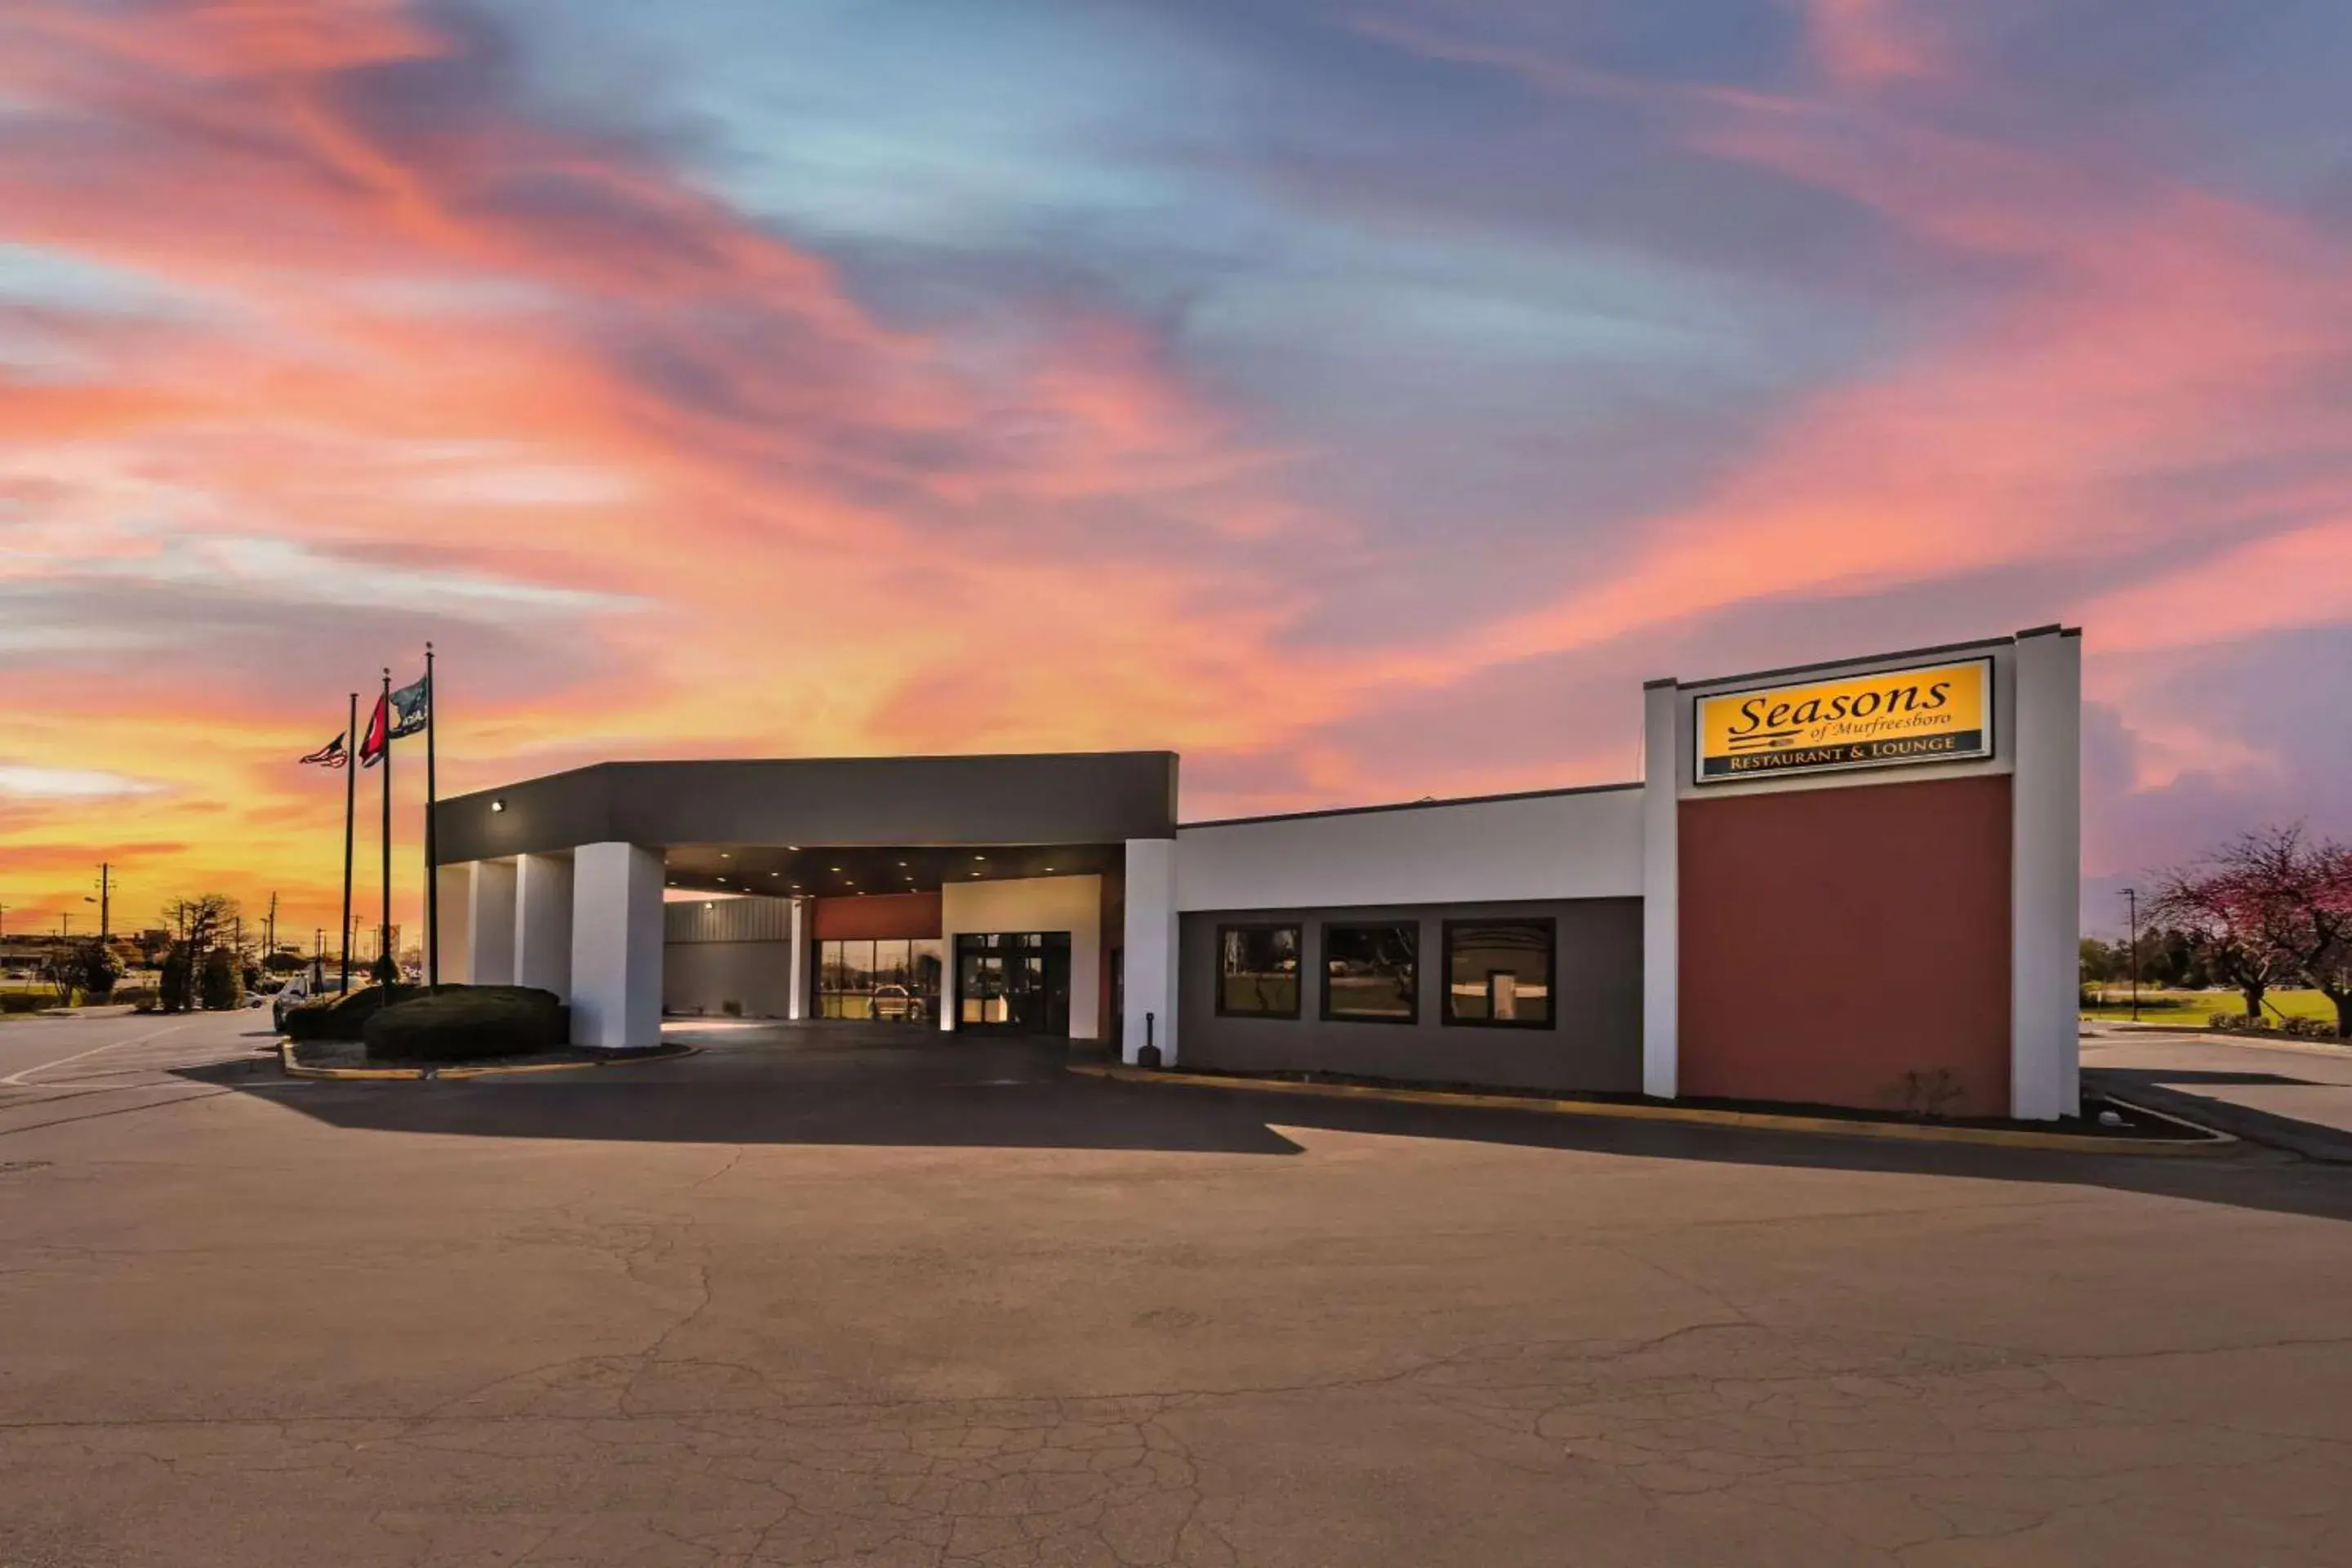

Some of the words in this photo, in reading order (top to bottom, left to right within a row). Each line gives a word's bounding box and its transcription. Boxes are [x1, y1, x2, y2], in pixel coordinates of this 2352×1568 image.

[1728, 683, 1950, 734] Seasons
[1811, 723, 1830, 742] of
[1832, 712, 1952, 737] Murfreesboro
[1731, 749, 1845, 769] RESTAURANT
[1850, 744, 1864, 760] &
[1871, 737, 1956, 757] LOUNGE
